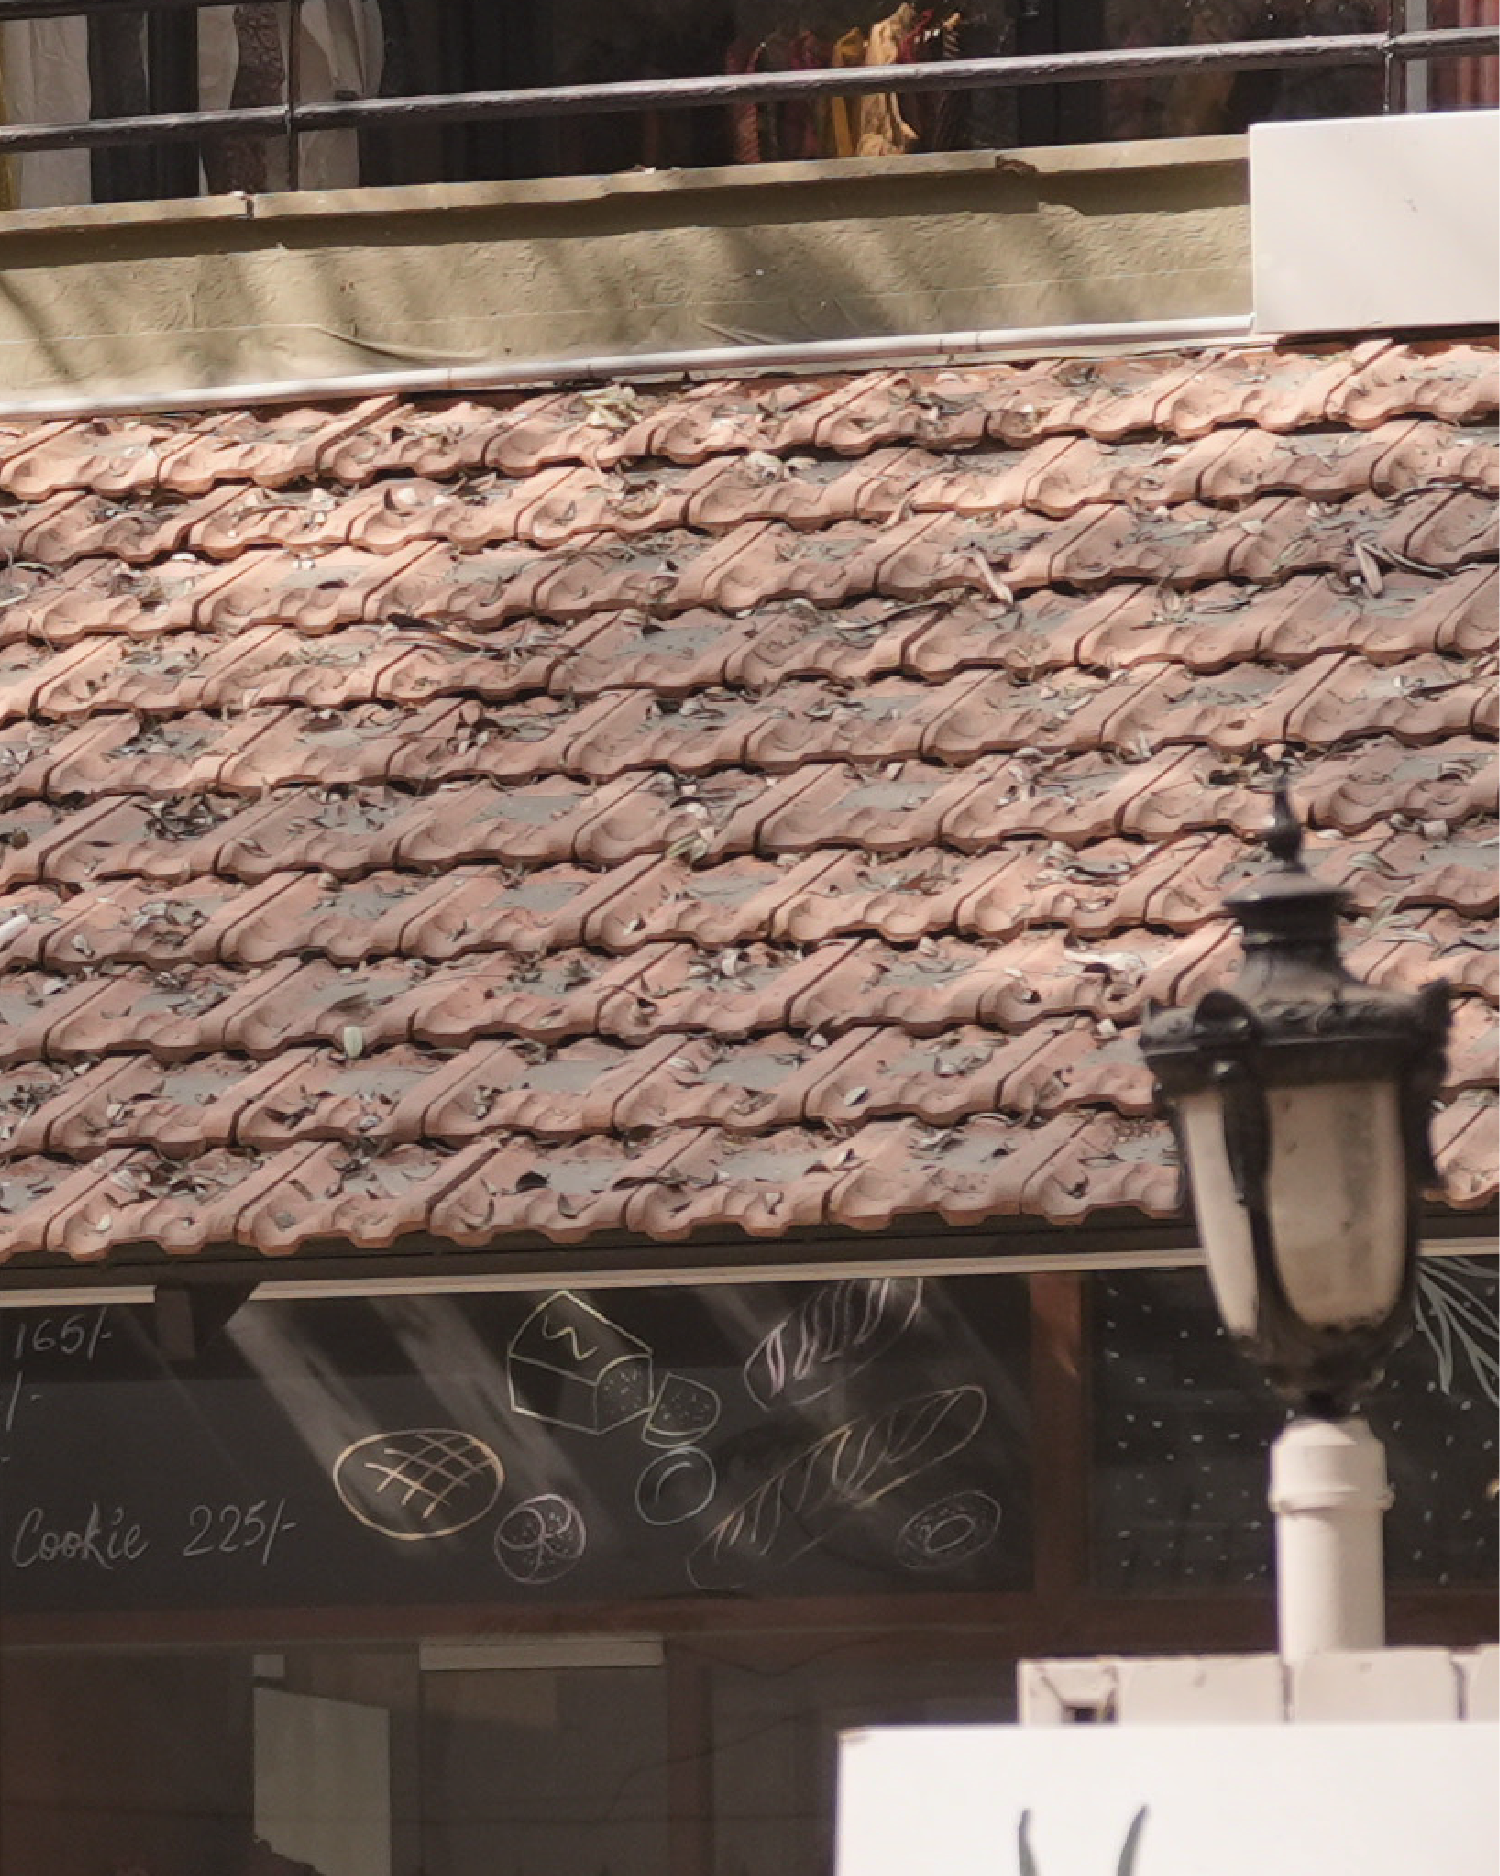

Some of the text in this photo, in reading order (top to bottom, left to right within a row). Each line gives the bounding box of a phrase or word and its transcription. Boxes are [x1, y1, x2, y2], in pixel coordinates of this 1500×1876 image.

[13, 1307, 113, 1362] 165/-
[12, 1502, 150, 1571] Cookie
[183, 1498, 297, 1566] 225/-
